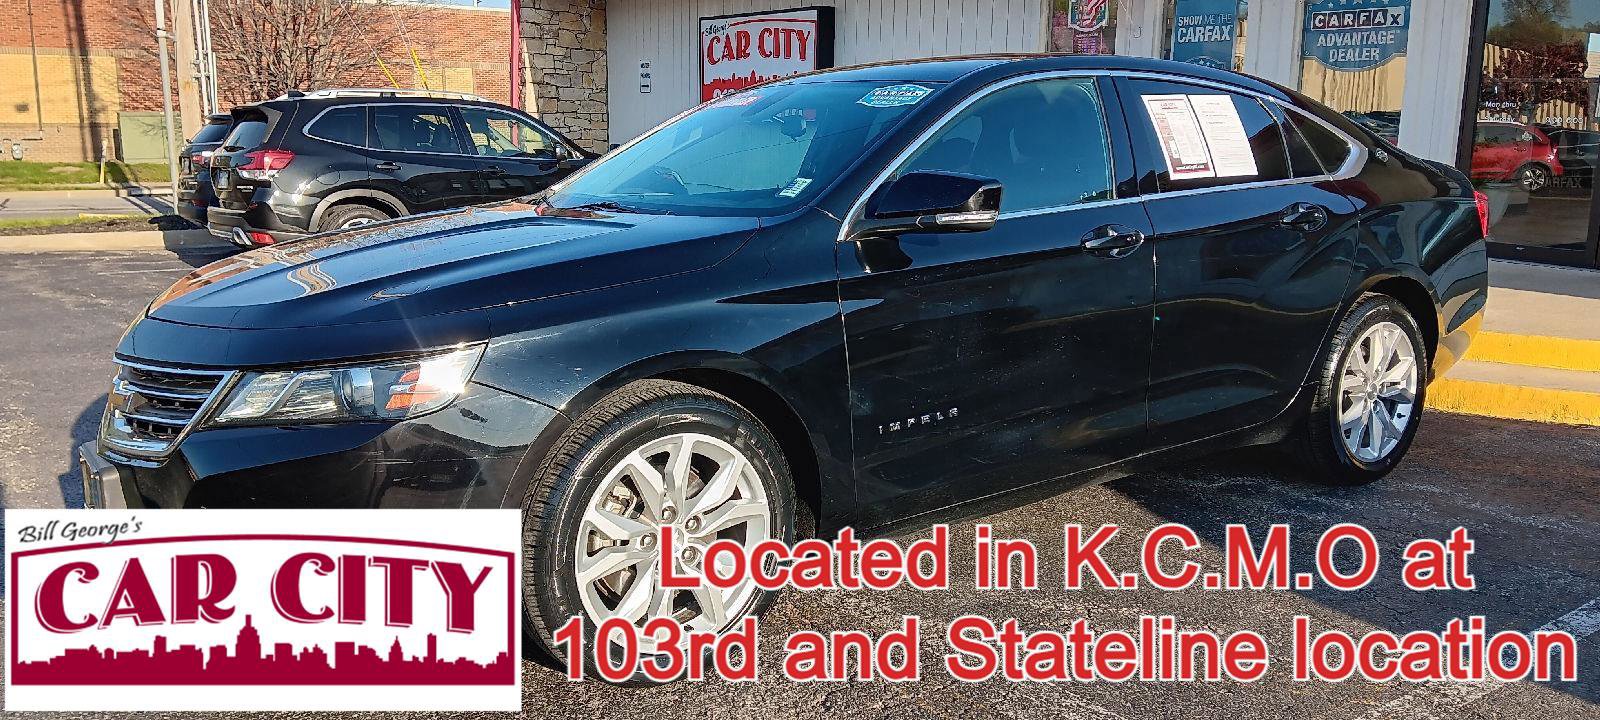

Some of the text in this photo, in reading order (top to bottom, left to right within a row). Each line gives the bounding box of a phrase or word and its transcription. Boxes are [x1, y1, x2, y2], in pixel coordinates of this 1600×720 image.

[1178, 15, 1202, 27] SHOW
[1218, 13, 1233, 24] THE
[1314, 11, 1402, 28] CARFAX
[1177, 25, 1232, 43] CARFAX
[1316, 30, 1395, 47] ADVANTAGE
[707, 30, 751, 65] CAR
[758, 27, 811, 62] CITY
[1329, 47, 1380, 62] DEALER
